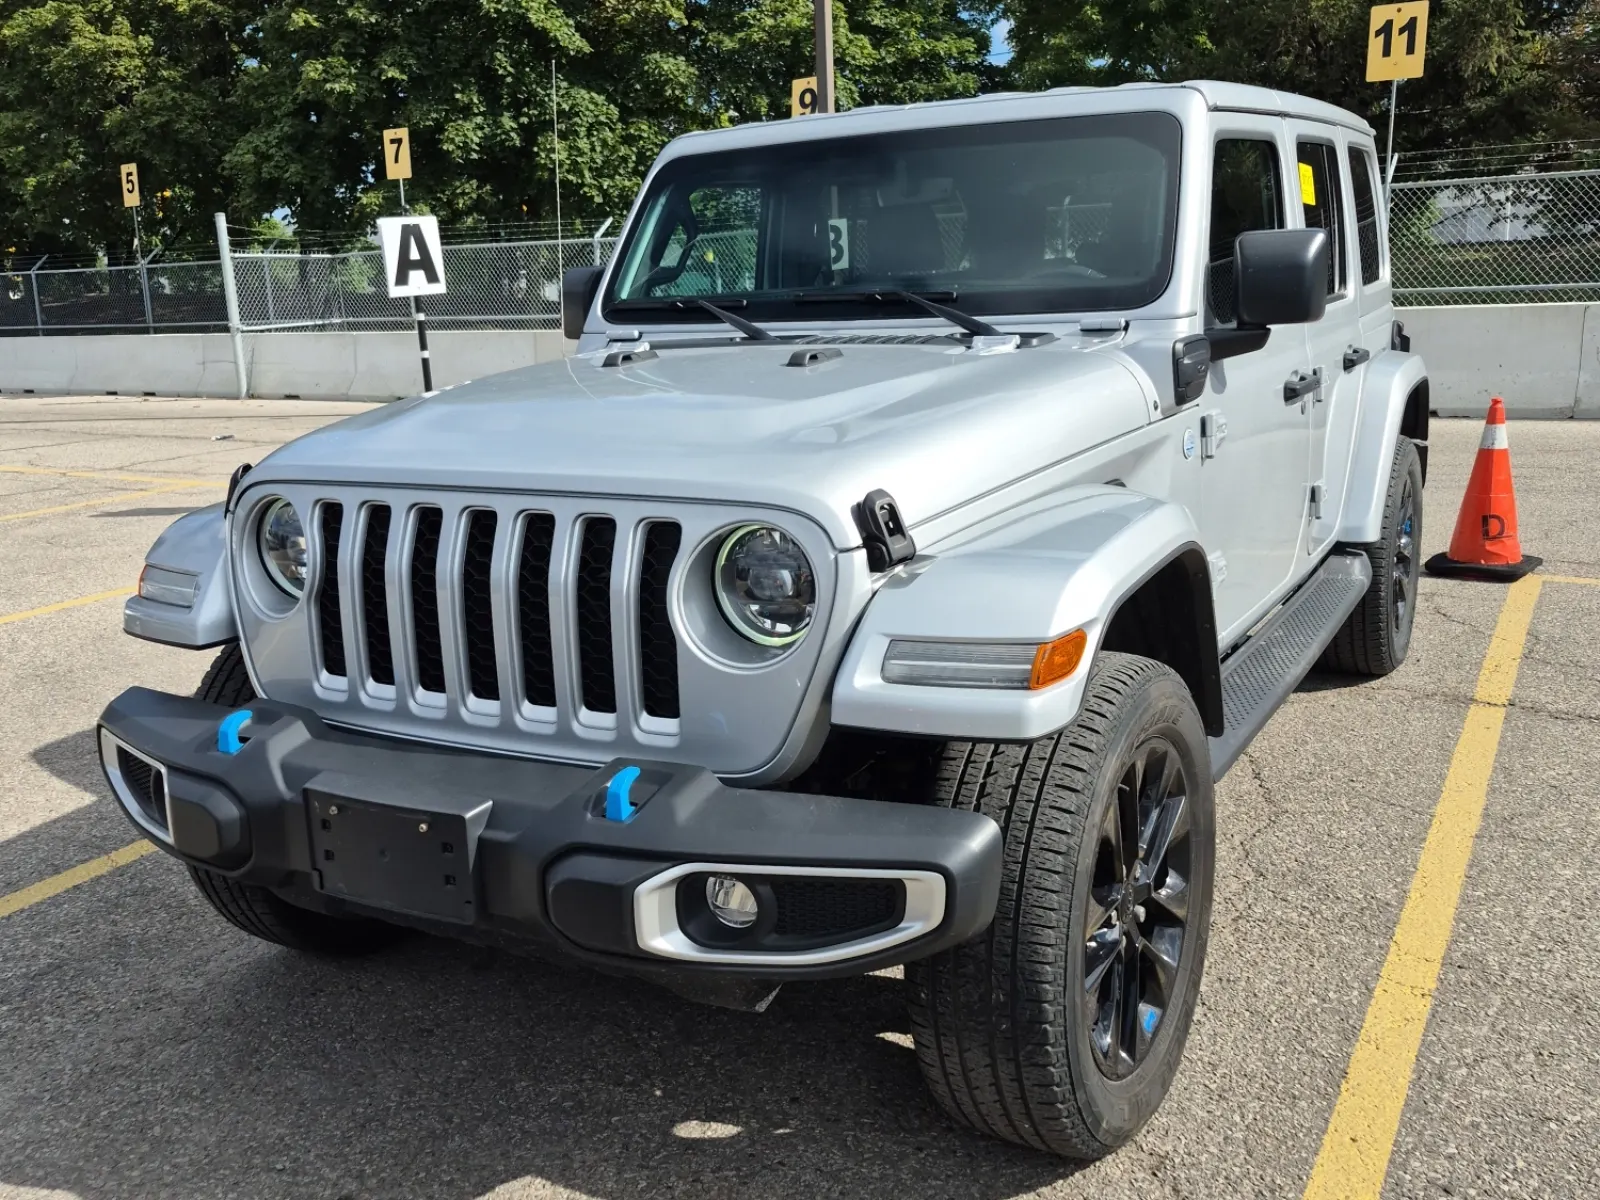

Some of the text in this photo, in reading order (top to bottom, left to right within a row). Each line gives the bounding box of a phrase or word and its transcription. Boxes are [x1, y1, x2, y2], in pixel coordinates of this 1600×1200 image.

[1375, 16, 1417, 58] 11
[799, 87, 818, 115] 9
[389, 137, 403, 164] 7
[126, 171, 135, 194] 5
[394, 223, 441, 287] A
[1481, 513, 1506, 541] D
